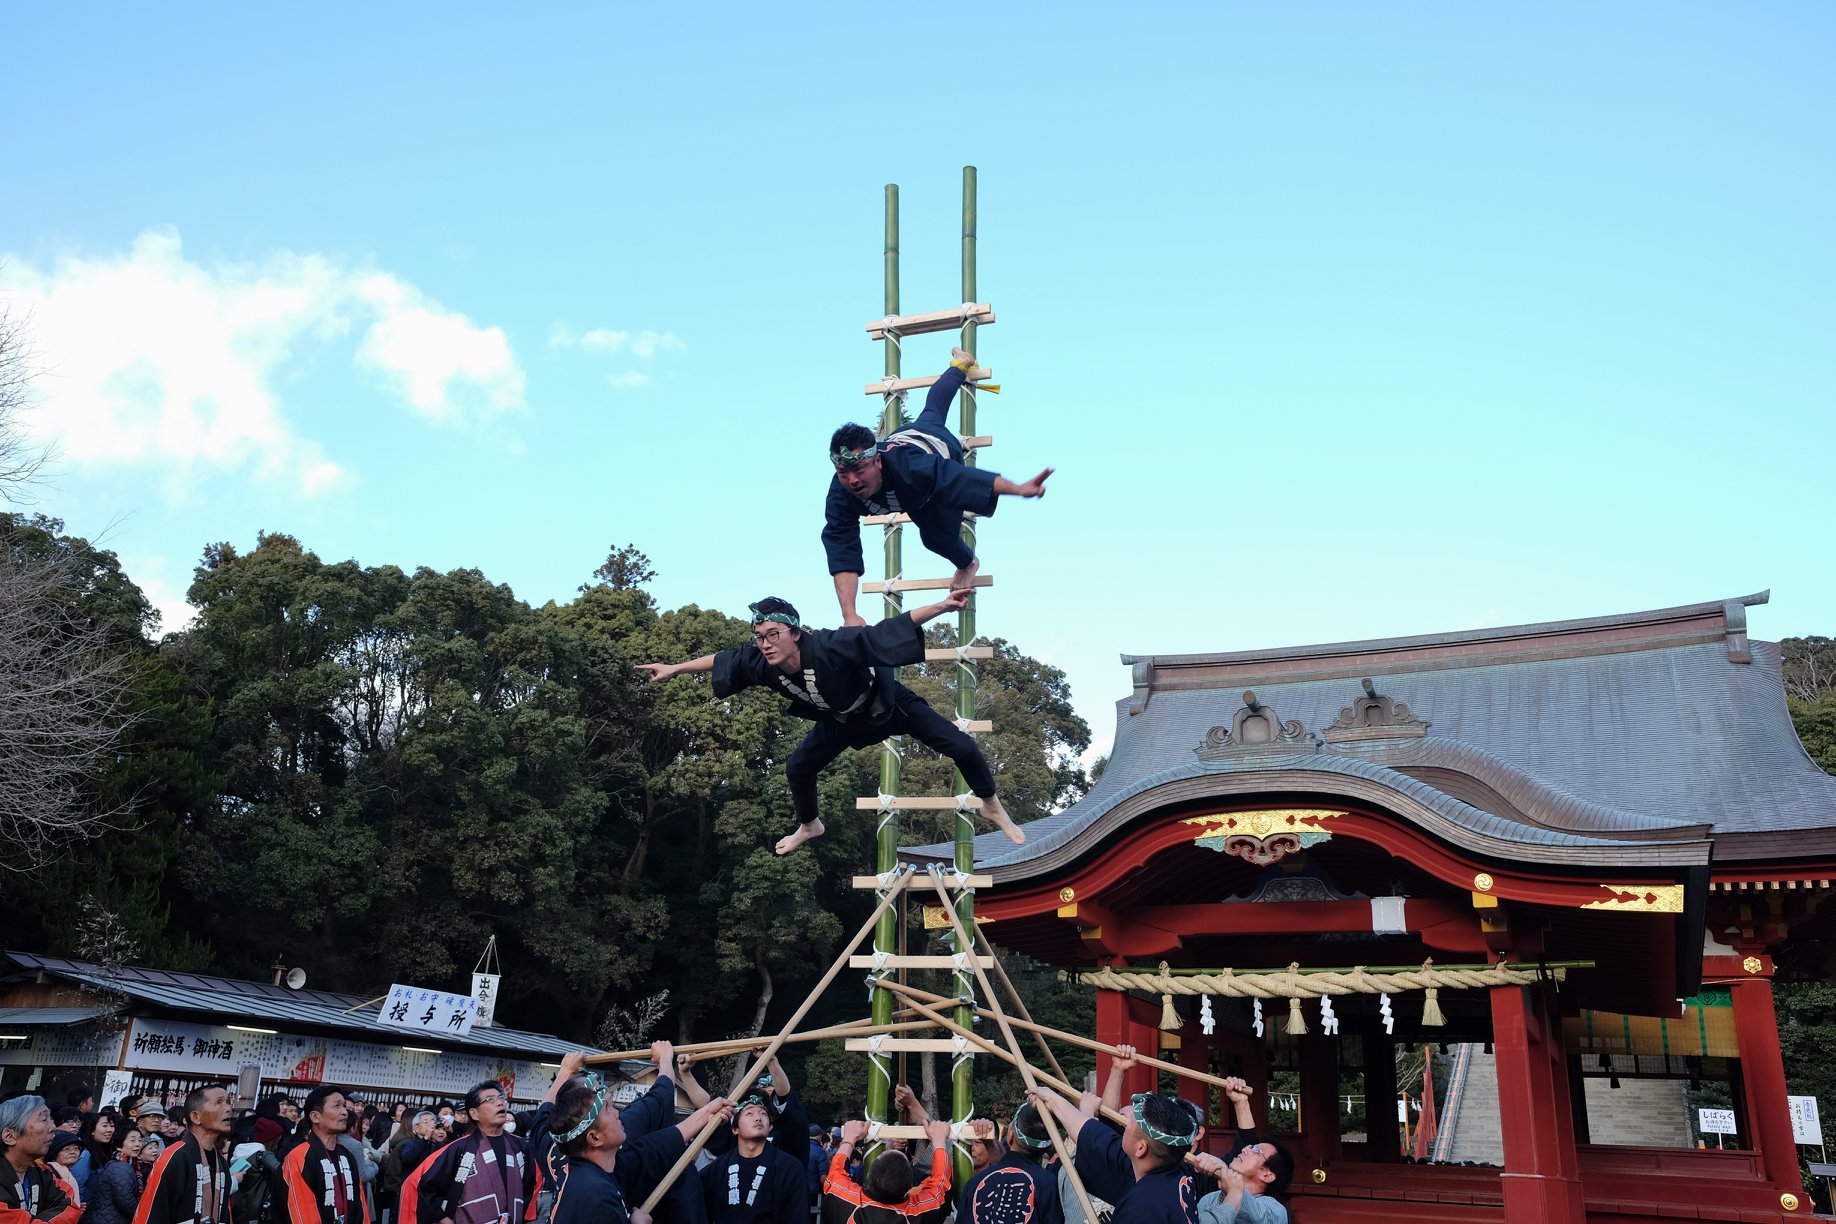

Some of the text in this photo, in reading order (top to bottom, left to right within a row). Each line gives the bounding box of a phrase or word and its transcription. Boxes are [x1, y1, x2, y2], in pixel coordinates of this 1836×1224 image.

[389, 1000, 467, 1031] 授与所
[134, 1032, 234, 1061] 祈願絵馬・御神酒
[1703, 1110, 1733, 1120] しばらく
